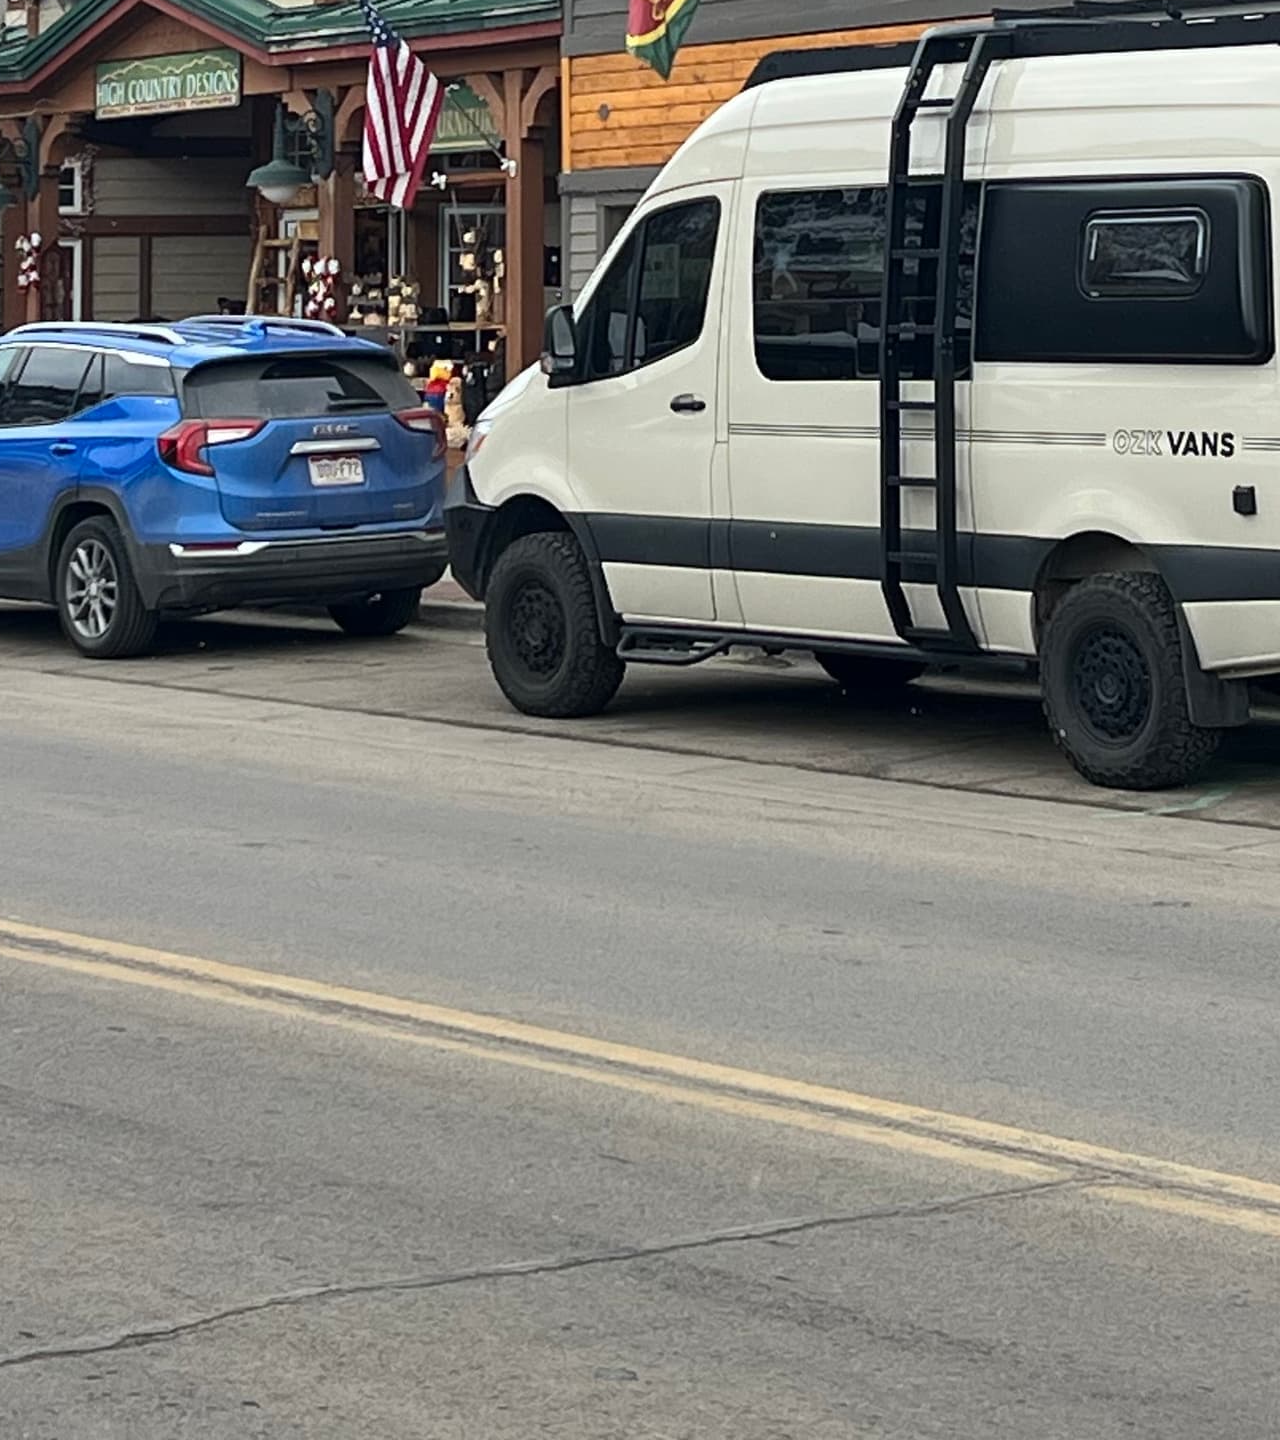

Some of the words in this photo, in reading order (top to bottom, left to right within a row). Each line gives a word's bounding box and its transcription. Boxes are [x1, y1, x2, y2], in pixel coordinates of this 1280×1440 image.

[96, 82, 126, 106] HIGH
[127, 75, 182, 103] COUNTRY
[185, 68, 238, 98] DESIGNS
[1112, 429, 1161, 456] OZK
[1166, 431, 1235, 457] VANS
